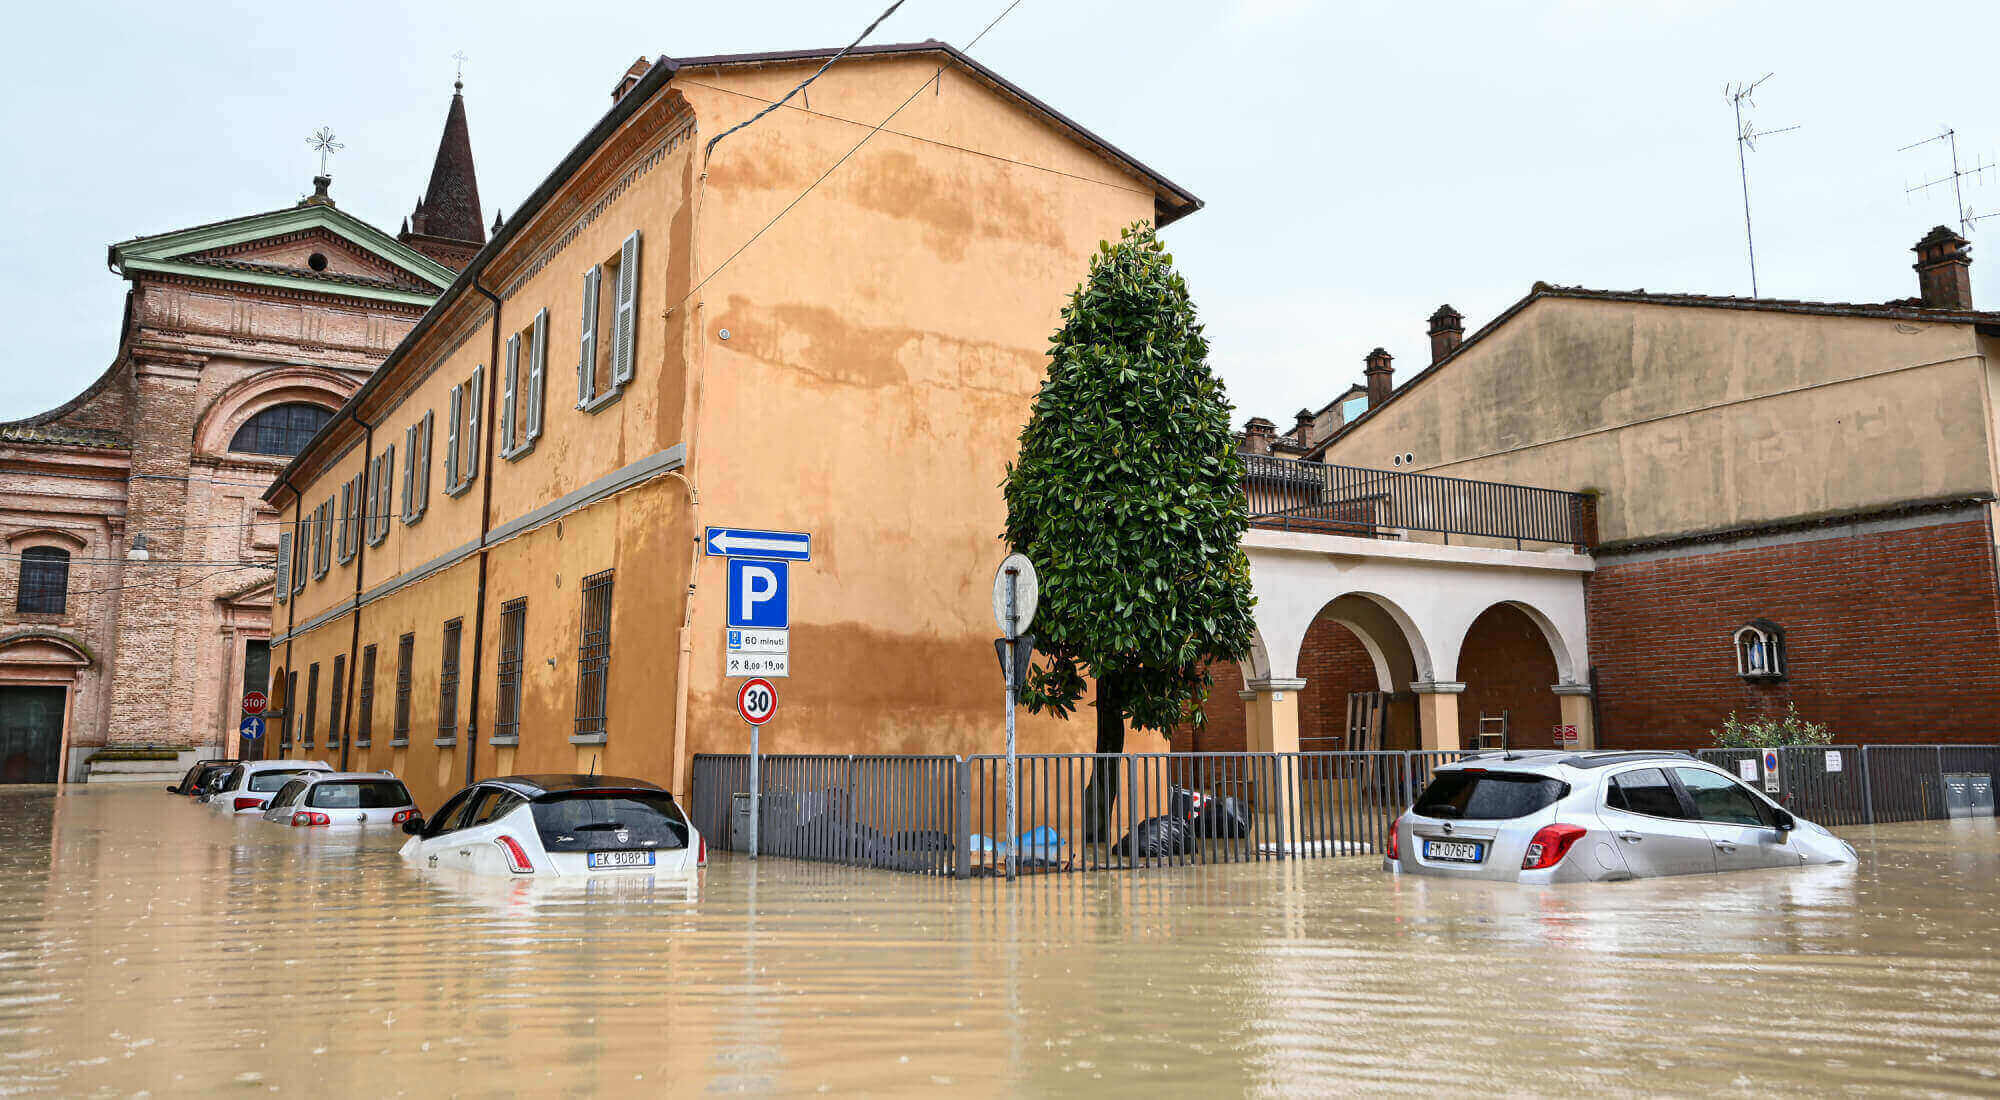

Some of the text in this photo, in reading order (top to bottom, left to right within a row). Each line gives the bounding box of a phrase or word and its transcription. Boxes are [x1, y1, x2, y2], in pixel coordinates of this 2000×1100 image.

[742, 566, 778, 620] P
[745, 636, 784, 646] 60 minuti
[243, 698, 266, 708] STOP
[747, 690, 769, 713] 30
[1429, 843, 1475, 858] FM 076FC
[596, 853, 610, 865] EK
